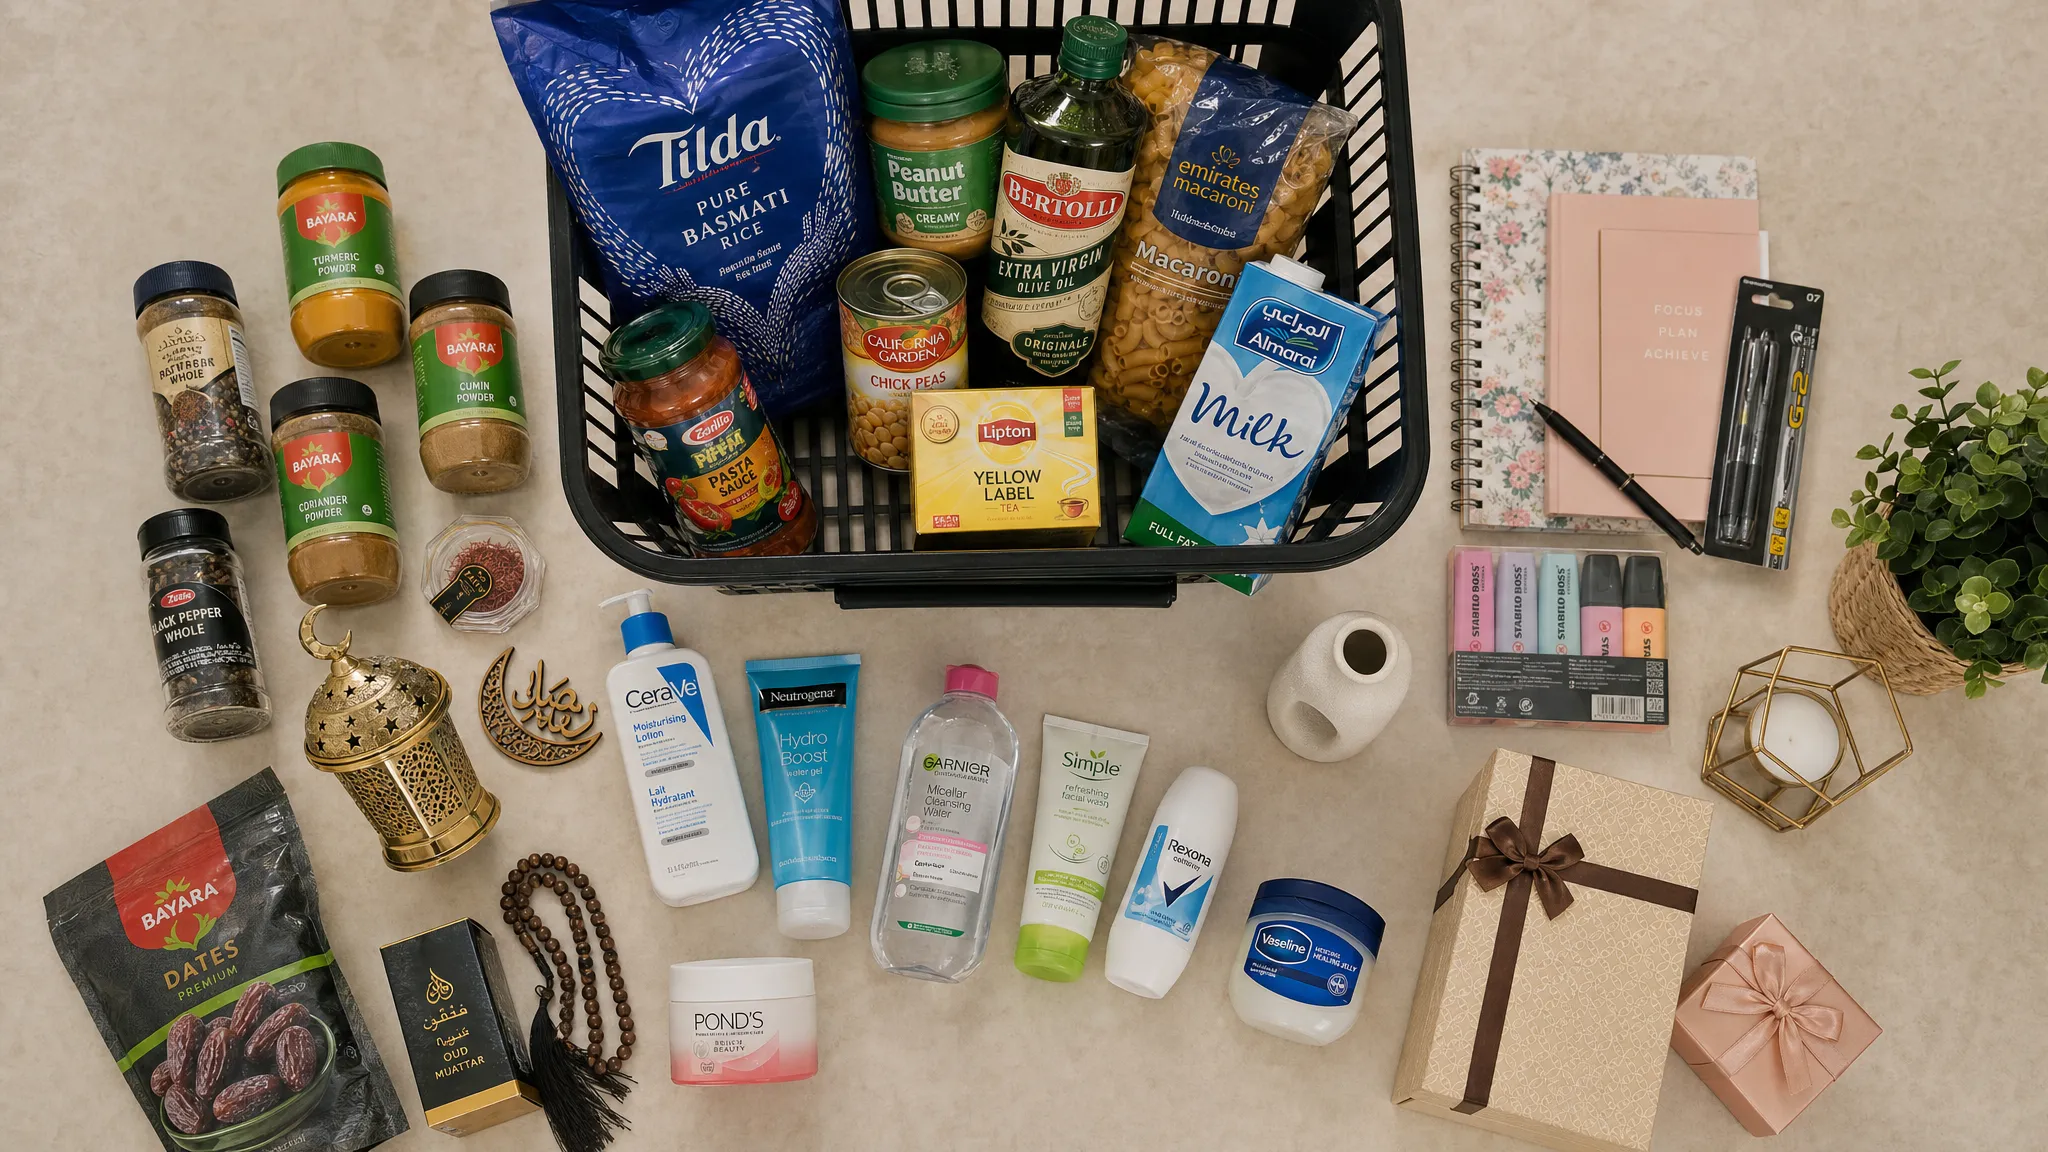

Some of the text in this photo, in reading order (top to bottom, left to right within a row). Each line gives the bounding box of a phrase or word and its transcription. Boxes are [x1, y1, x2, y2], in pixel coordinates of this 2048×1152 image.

[628, 113, 776, 190] Tilda
[888, 159, 965, 183] Peanut
[1178, 160, 1261, 199] emirates
[696, 181, 751, 216] PURE
[892, 180, 962, 203] Butter
[1008, 176, 1118, 219] BERTOLLI
[1173, 175, 1256, 215] macaroni
[306, 211, 356, 229] BAYARA
[682, 188, 790, 247] BASMATI
[916, 211, 960, 224] CREAMY
[720, 221, 764, 250] RICE
[312, 252, 360, 266] TURMERIC
[998, 244, 1104, 280] EXTRA VIRGIN
[1135, 240, 1243, 288] Macaron
[318, 263, 357, 276] POWDER
[1017, 276, 1075, 294] OLIVE OIL
[1806, 293, 1821, 303] 07
[1654, 304, 1703, 317] FOCUS
[1262, 305, 1331, 341] المراعي
[1659, 326, 1698, 339] PLAN
[446, 341, 496, 355] BAYARA
[867, 331, 945, 350] CALIFORNIA
[1024, 336, 1089, 351] ORIGINALE
[1247, 332, 1318, 370] Almarai
[1644, 348, 1710, 362] ACHIEVE
[169, 369, 204, 385] WHOLE
[459, 381, 490, 391] CUMIN
[870, 371, 946, 391] CHICK PEAS
[456, 393, 495, 403] POWDER
[1788, 370, 1809, 429] G-2
[1190, 382, 1305, 459] Milk
[983, 425, 1031, 442] Lipton
[292, 452, 342, 473] BAYARA
[707, 456, 754, 489] PASTA
[719, 469, 758, 497] SAUCE
[973, 469, 1042, 485] YELLOW
[298, 495, 348, 513] CORIANDER
[984, 486, 1035, 502] LABEL
[305, 507, 343, 523] POWDER
[1000, 503, 1020, 513] TEA
[1148, 521, 1174, 542] FULL
[1472, 565, 1480, 637] STABILO BOSS
[1514, 566, 1522, 639] STABILO BOSS
[1557, 568, 1566, 640] STABILO BOSS
[178, 607, 223, 624] PEPPER
[164, 623, 205, 644] WHOLE
[625, 679, 698, 709] CeraVe
[770, 689, 834, 703] Neutrogena
[633, 714, 687, 733] Moisturising
[780, 731, 828, 750] Hydro
[780, 748, 828, 767] Boost
[923, 756, 990, 778] GARNIER
[1062, 751, 1120, 777] Simple
[926, 784, 968, 799] Micellar
[1061, 791, 1085, 803] facial
[1064, 784, 1109, 800] refreshing
[1167, 838, 1212, 868] Rexona
[141, 882, 219, 931] BAYARA
[1262, 932, 1306, 955] Vaseline
[163, 939, 240, 991] DATES
[177, 964, 238, 1001] PREMIUM
[694, 1011, 764, 1031] POND'S
[443, 1046, 468, 1062] OUD
[713, 1045, 745, 1053] BEAUTY
[434, 1055, 486, 1080] MUATTAR
